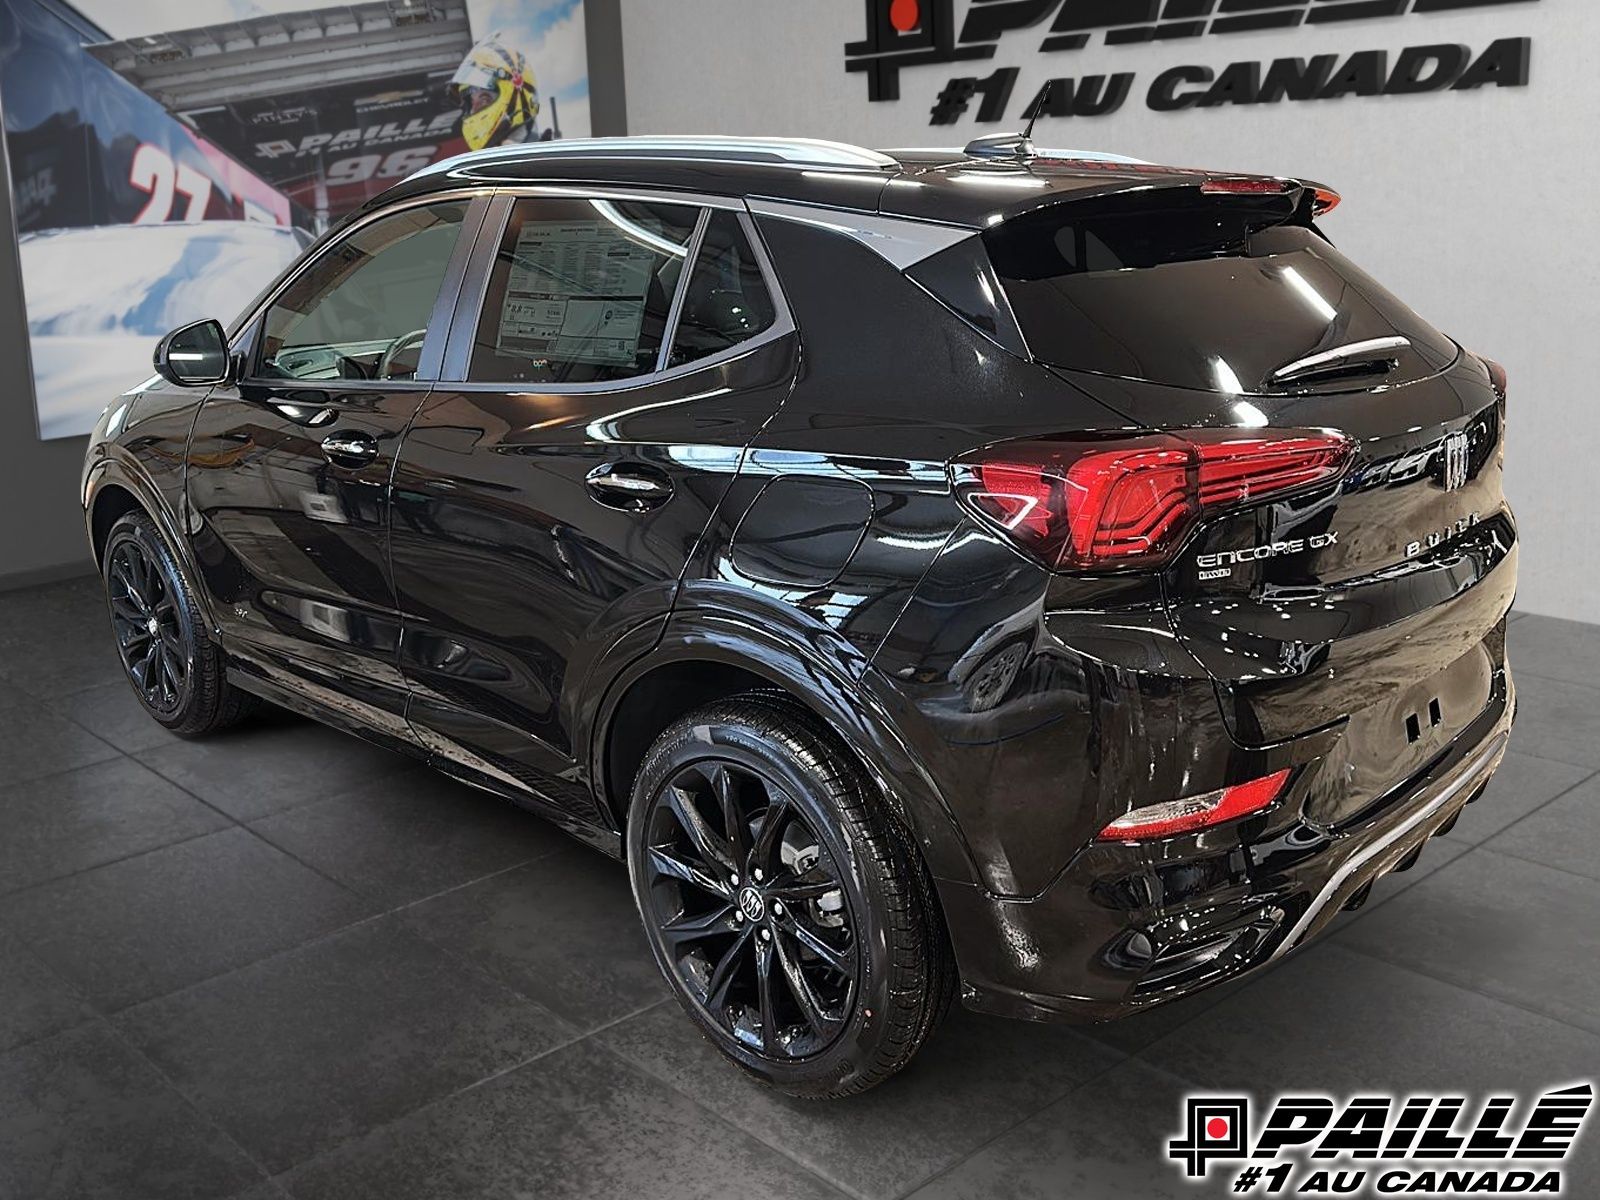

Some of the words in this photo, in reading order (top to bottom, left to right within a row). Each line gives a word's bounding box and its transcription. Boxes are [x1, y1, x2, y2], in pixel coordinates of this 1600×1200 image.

[930, 66, 1021, 125] #1
[1020, 72, 1135, 119] AU
[1145, 37, 1532, 112] CANADA
[356, 97, 429, 113] CHEVROLET
[365, 128, 453, 144] CANADA
[130, 142, 212, 224] 27
[1196, 538, 1305, 568] ENCORE
[1309, 531, 1339, 549] GX
